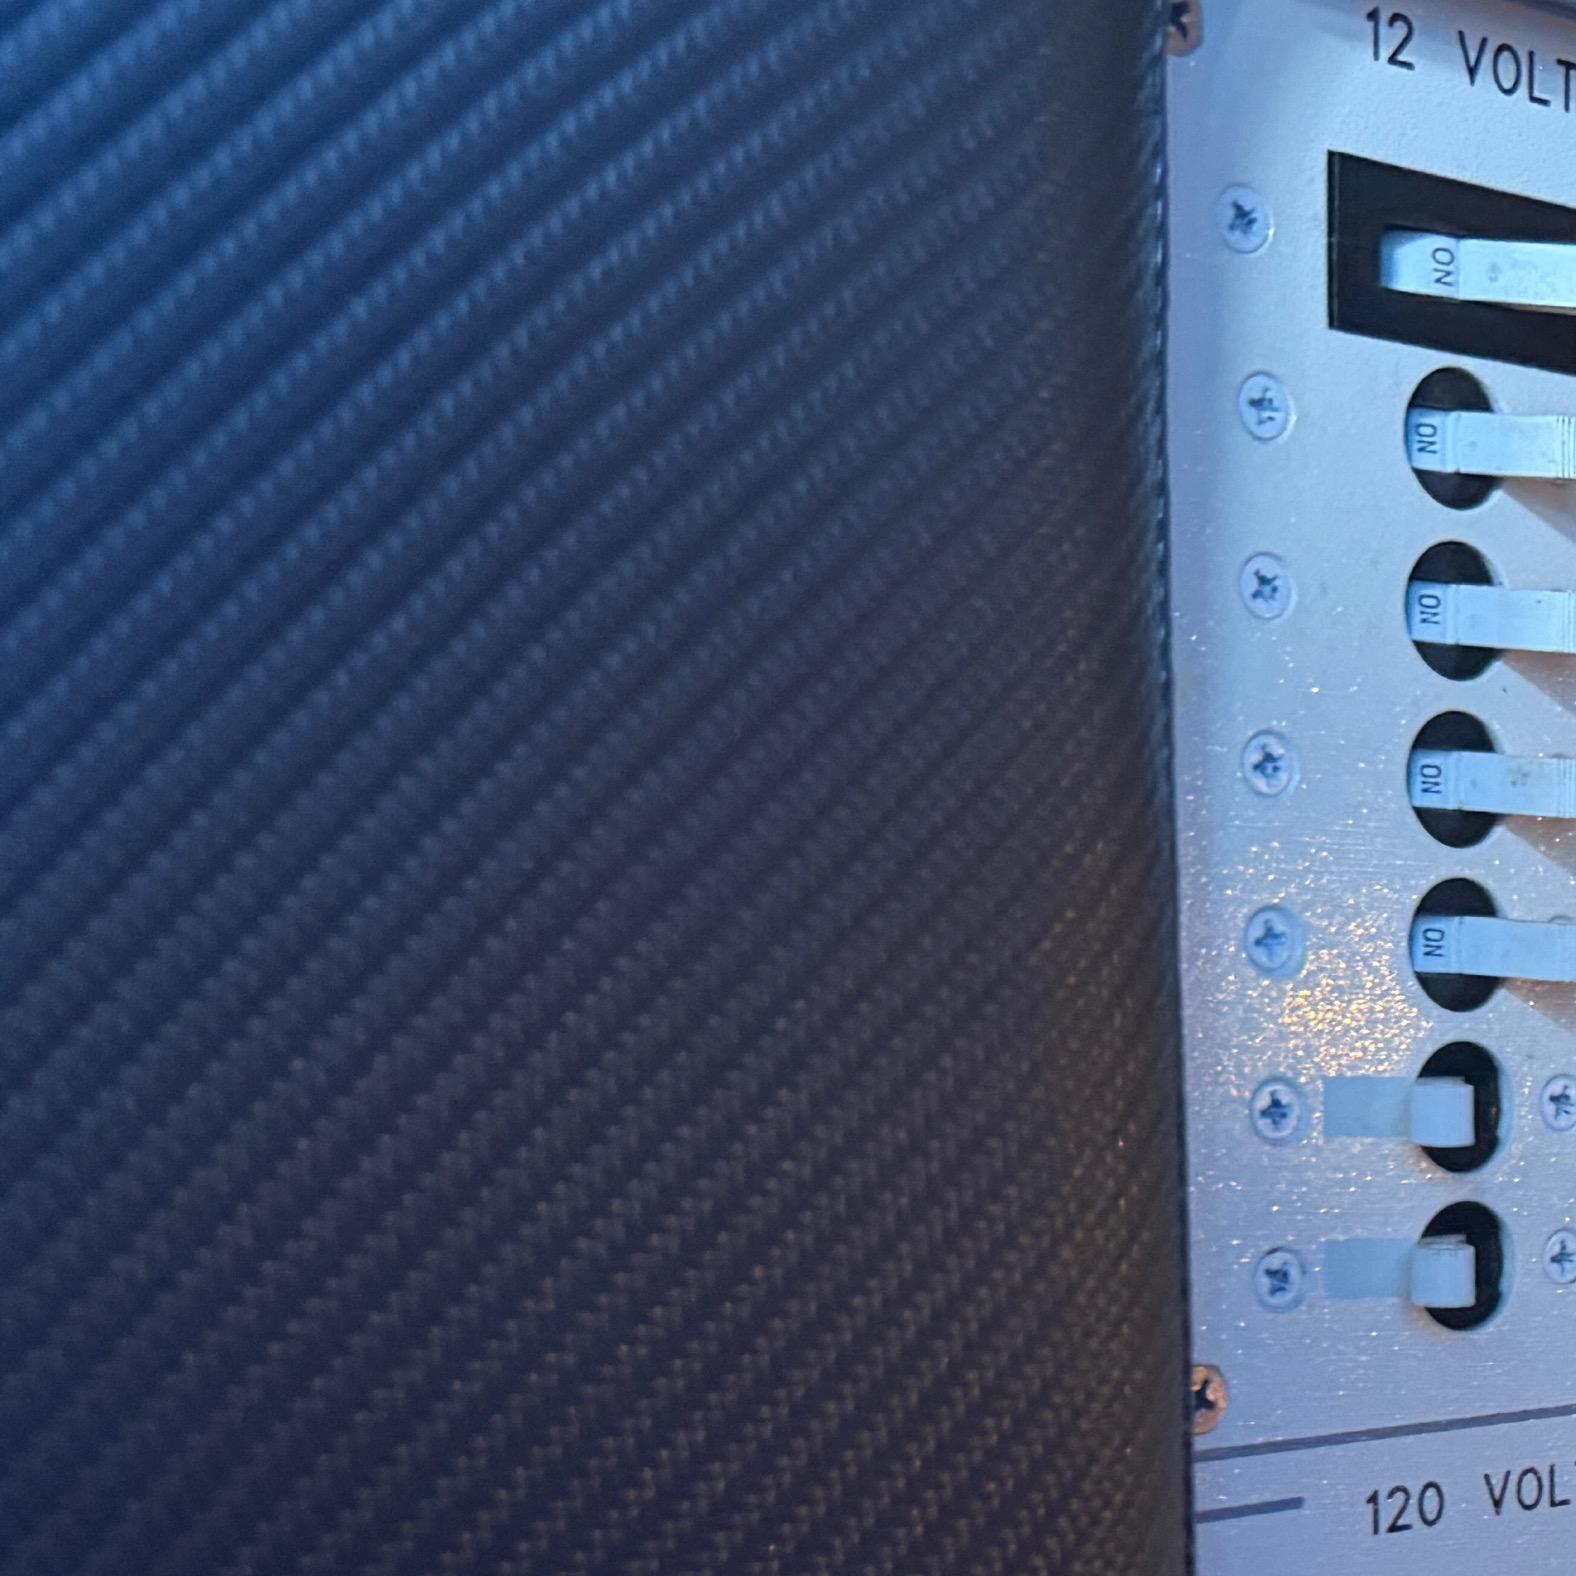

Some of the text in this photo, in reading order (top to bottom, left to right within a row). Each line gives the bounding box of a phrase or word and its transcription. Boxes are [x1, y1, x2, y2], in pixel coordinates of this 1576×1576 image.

[1365, 5, 1416, 70] 12
[1432, 247, 1455, 286] ON
[1416, 422, 1439, 455] ON
[1419, 594, 1442, 625] ON
[1419, 762, 1443, 795] ON
[1423, 926, 1446, 958] ON
[1365, 1481, 1445, 1536] 120
